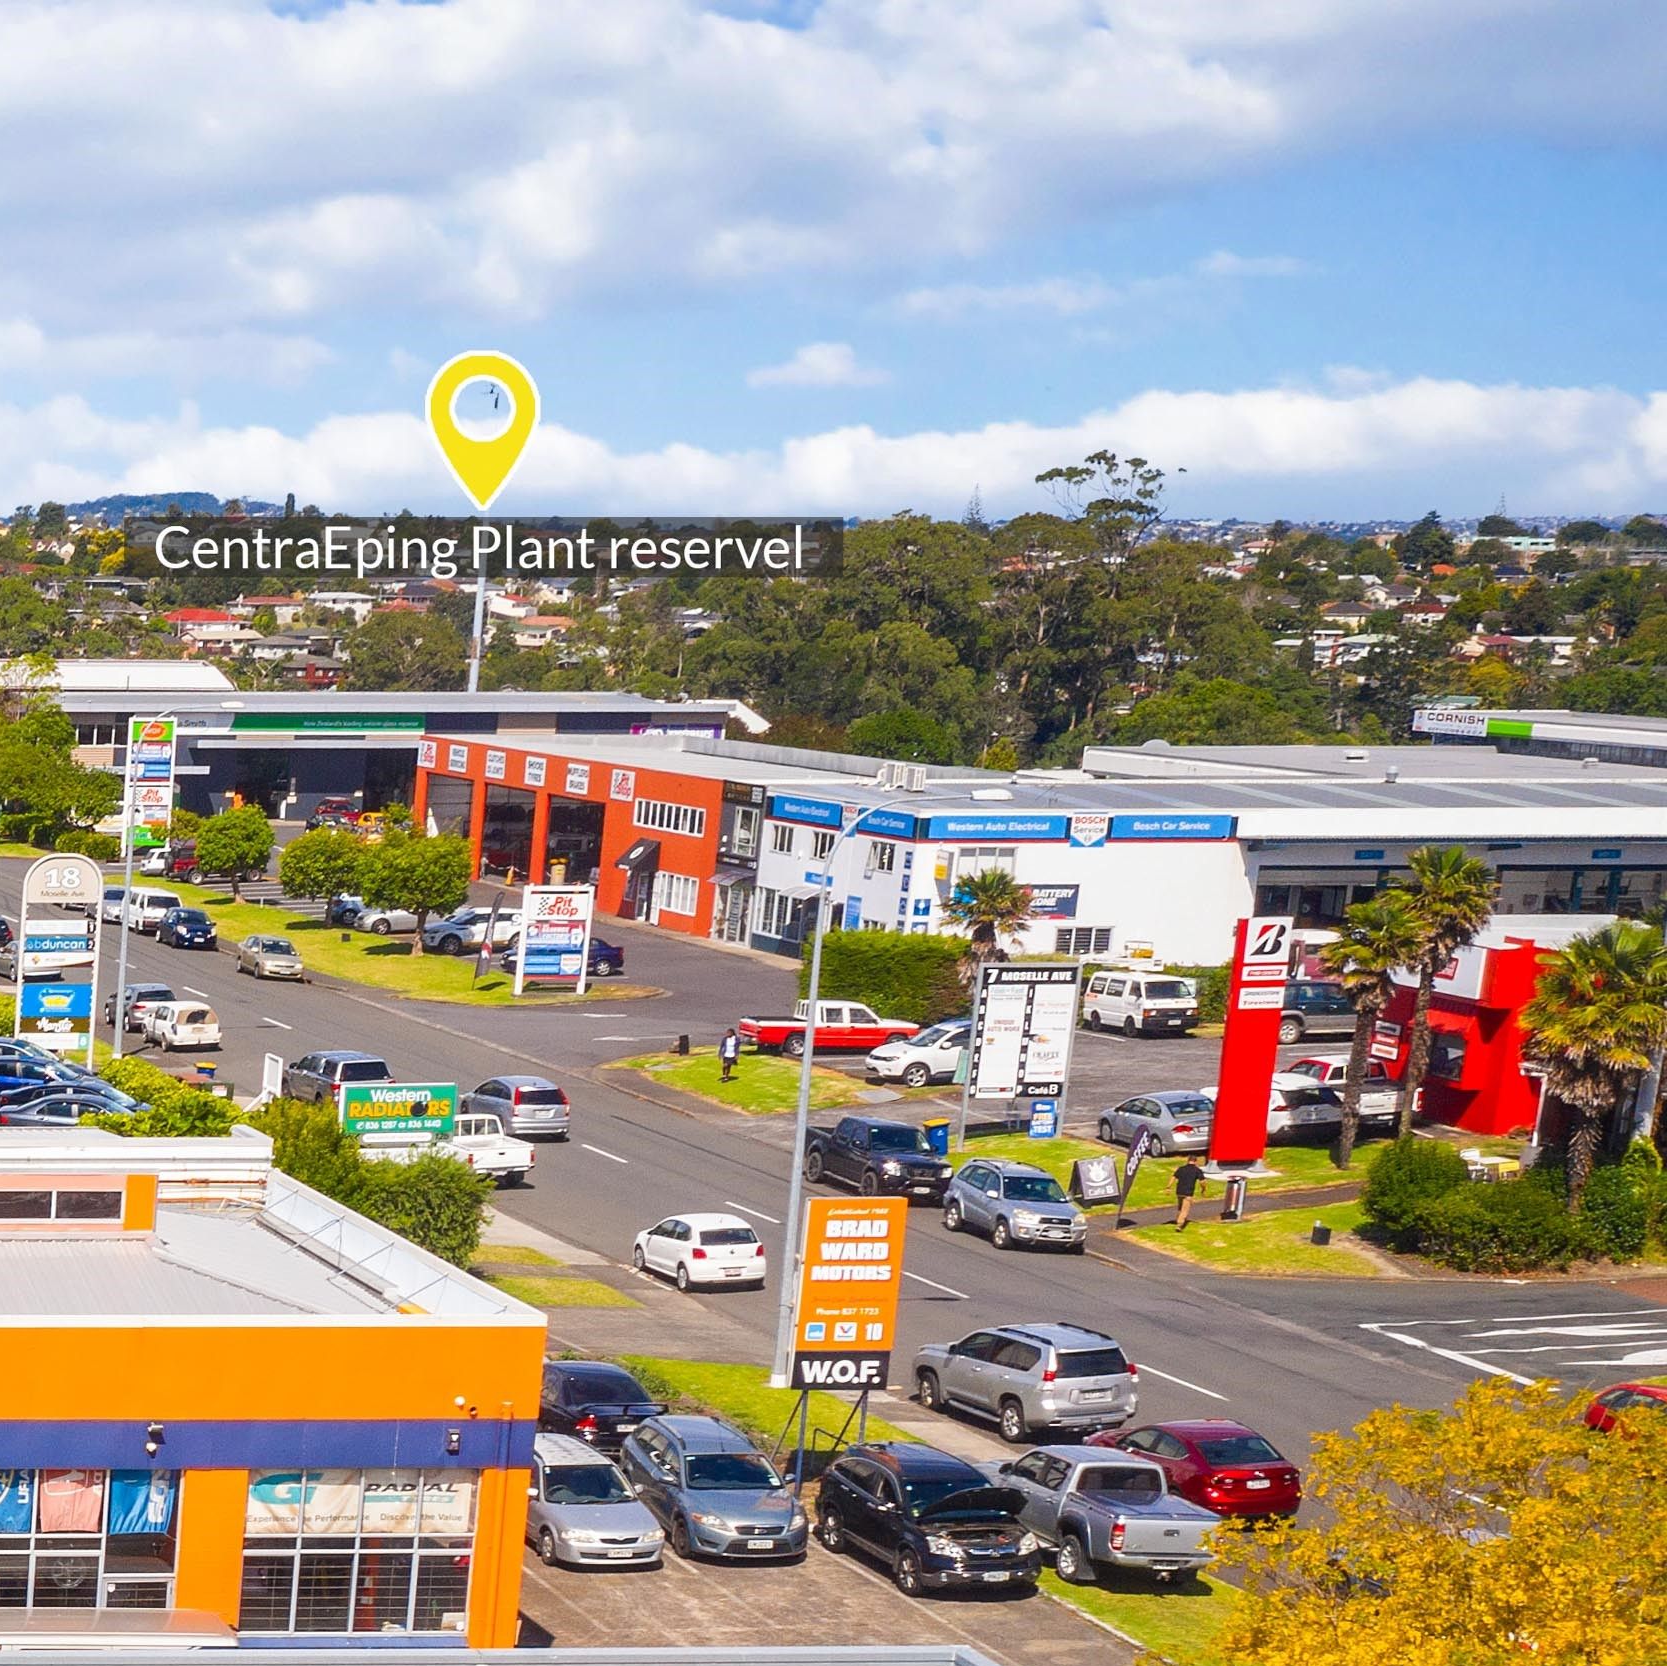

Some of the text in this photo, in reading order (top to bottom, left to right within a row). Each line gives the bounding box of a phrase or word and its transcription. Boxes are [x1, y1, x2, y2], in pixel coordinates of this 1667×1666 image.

[1427, 712, 1485, 726] CORNISH
[1073, 815, 1107, 826] BOSCH
[1133, 821, 1211, 831] Bosch Car Service
[946, 821, 1050, 832] Western Auto Electrical
[1073, 825, 1105, 834] Service
[44, 866, 81, 889] 18
[553, 896, 573, 907] Pit
[547, 905, 579, 917] Stop
[986, 969, 1072, 984] 7 MOSELLE AVE
[1048, 1084, 1059, 1095] B
[370, 1088, 432, 1103] Western
[825, 1219, 889, 1238] BRAD
[820, 1242, 890, 1261] WARD
[810, 1265, 892, 1281] MOTORS
[815, 1307, 841, 1316] Phone
[801, 1359, 882, 1385] W.O.F.
[364, 1483, 459, 1493] RADAL
[438, 1513, 463, 1522] Value
